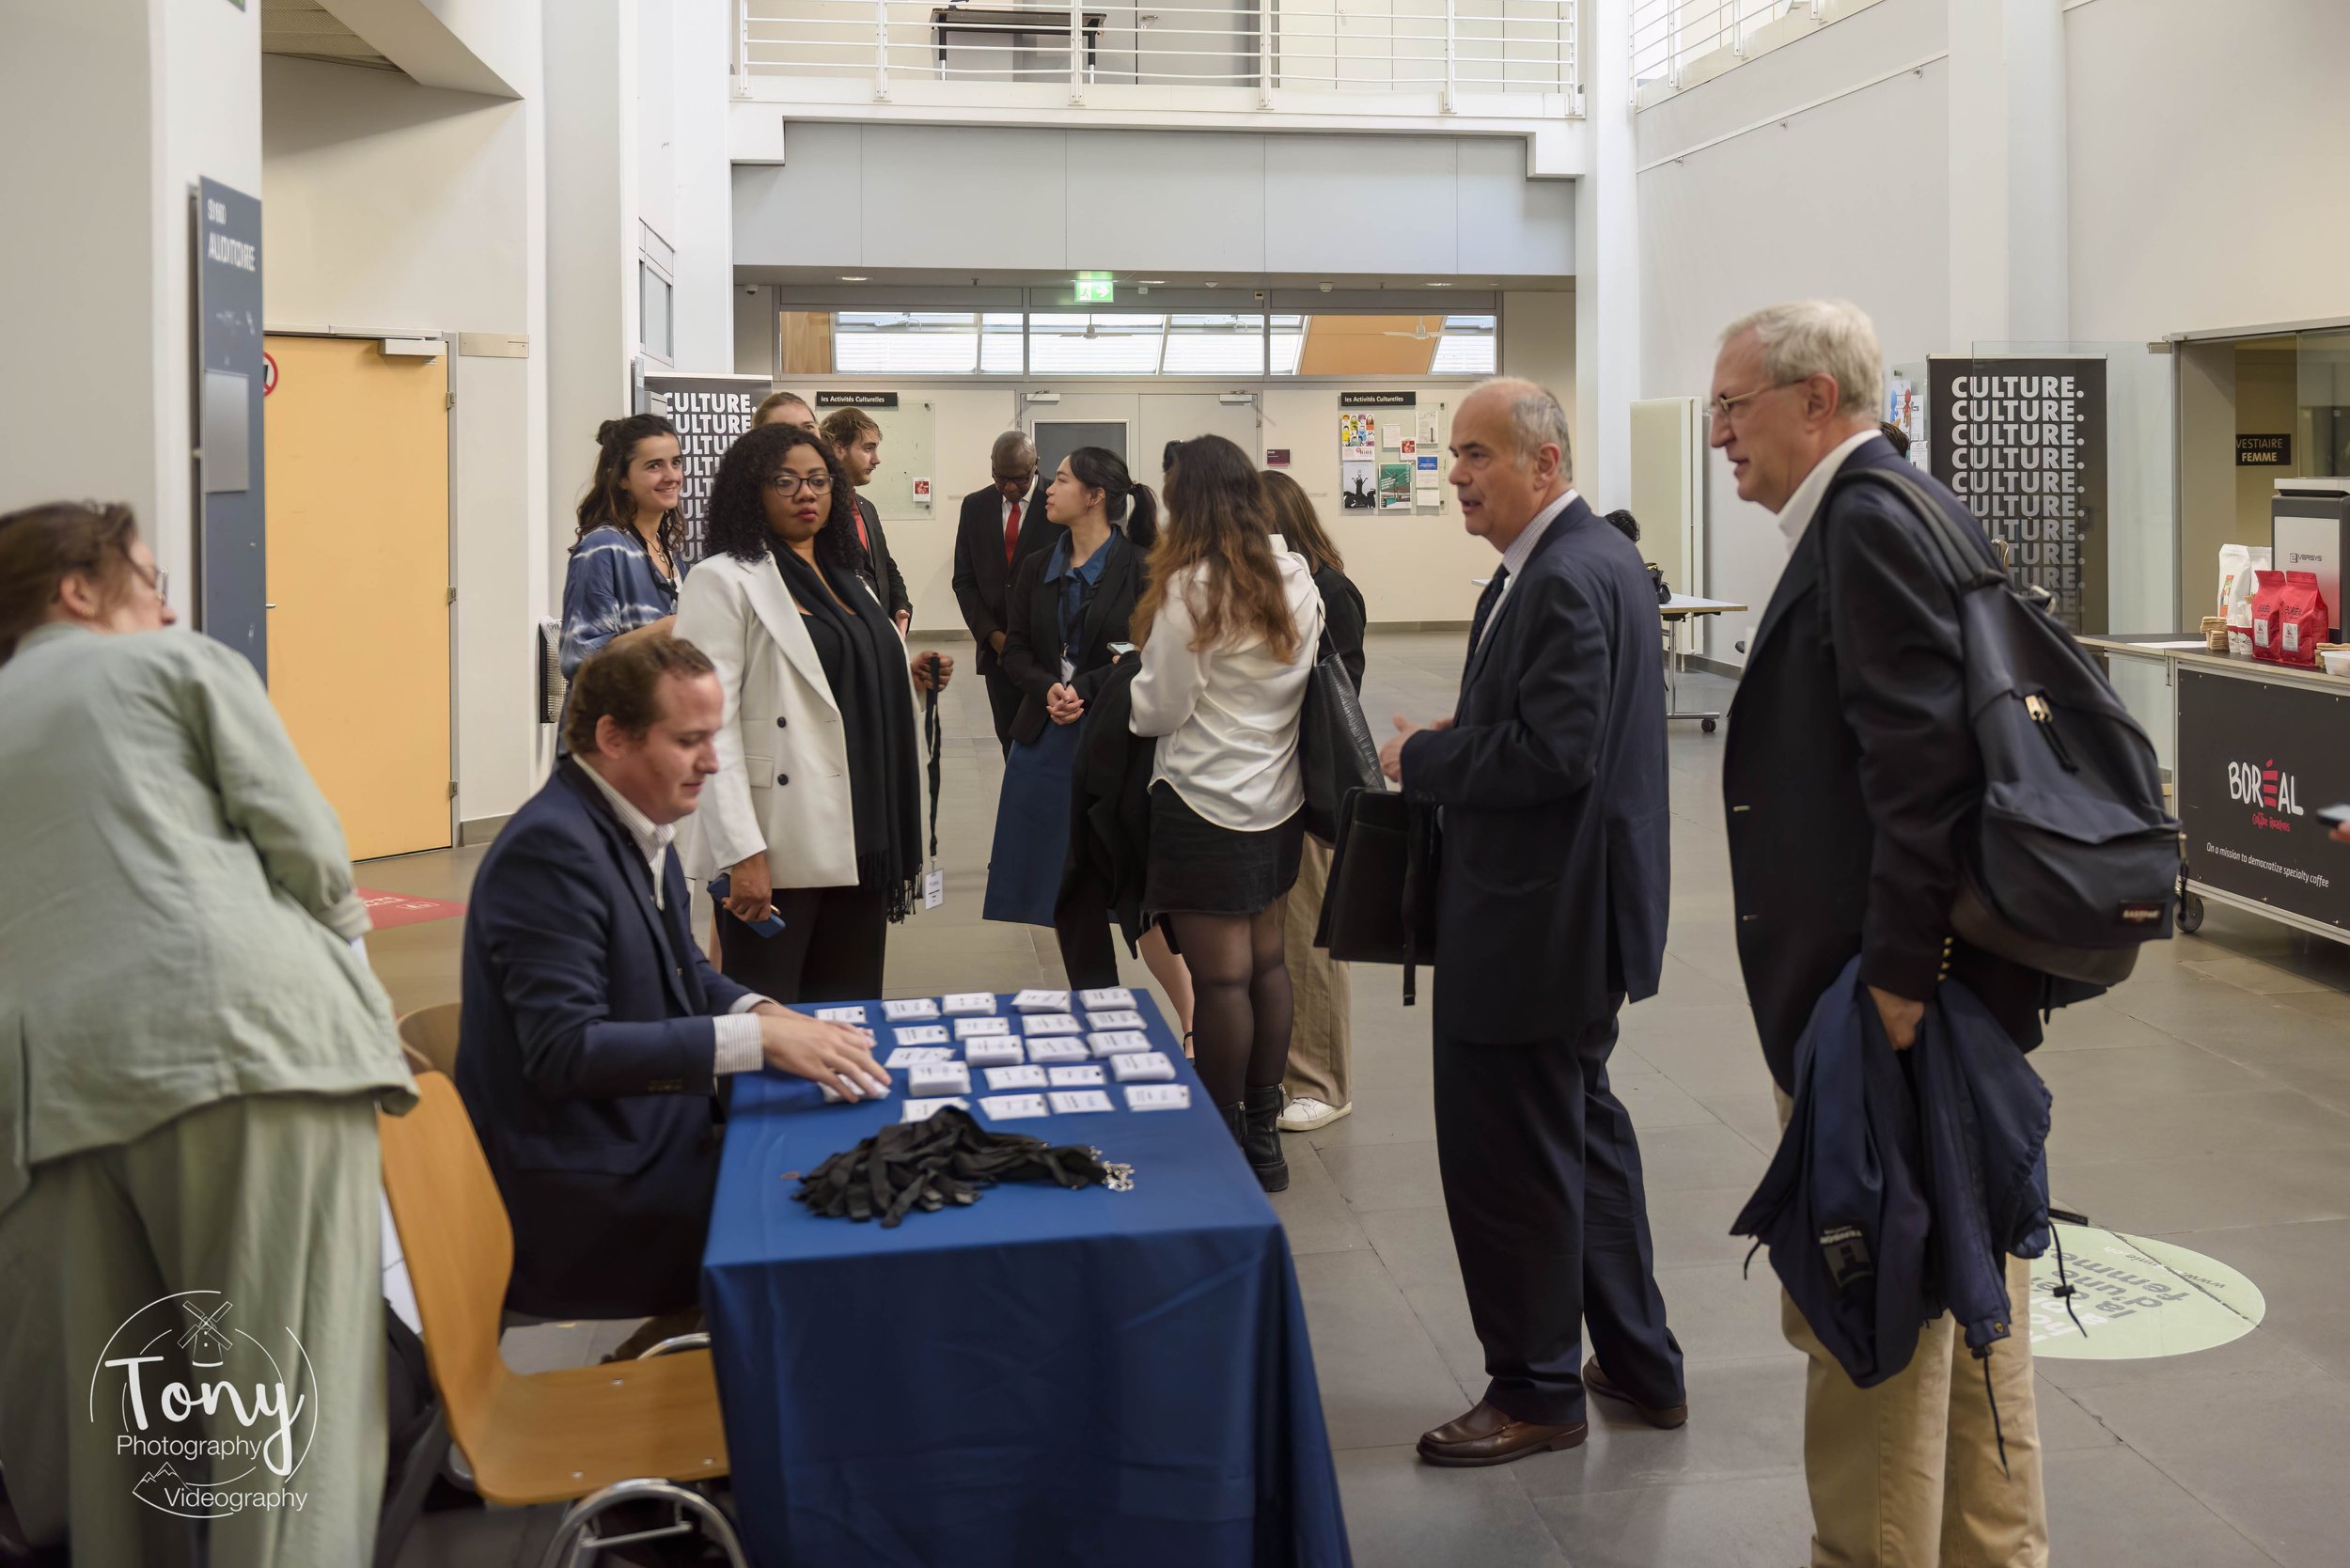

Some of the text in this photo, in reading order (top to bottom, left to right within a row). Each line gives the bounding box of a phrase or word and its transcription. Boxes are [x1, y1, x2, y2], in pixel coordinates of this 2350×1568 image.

[1951, 376, 2084, 398] CULTURE.
[663, 392, 758, 414] CULTURE.
[1951, 400, 2084, 422] CULTURE.
[1951, 424, 2084, 446] CULTURE.
[2236, 438, 2283, 448] VESTIAIRE
[1951, 447, 2085, 469] CULTURE.
[2241, 452, 2277, 462] FEMME
[1951, 472, 2085, 494] CULTURE.
[2228, 759, 2304, 816] BORÉAL
[2206, 842, 2215, 853] On
[2219, 847, 2241, 861] mission
[2241, 853, 2248, 863] to
[2248, 855, 2282, 873] democratize
[2283, 867, 2310, 884] specialty
[2310, 874, 2329, 887] coffee
[2094, 1300, 2138, 1319] la
